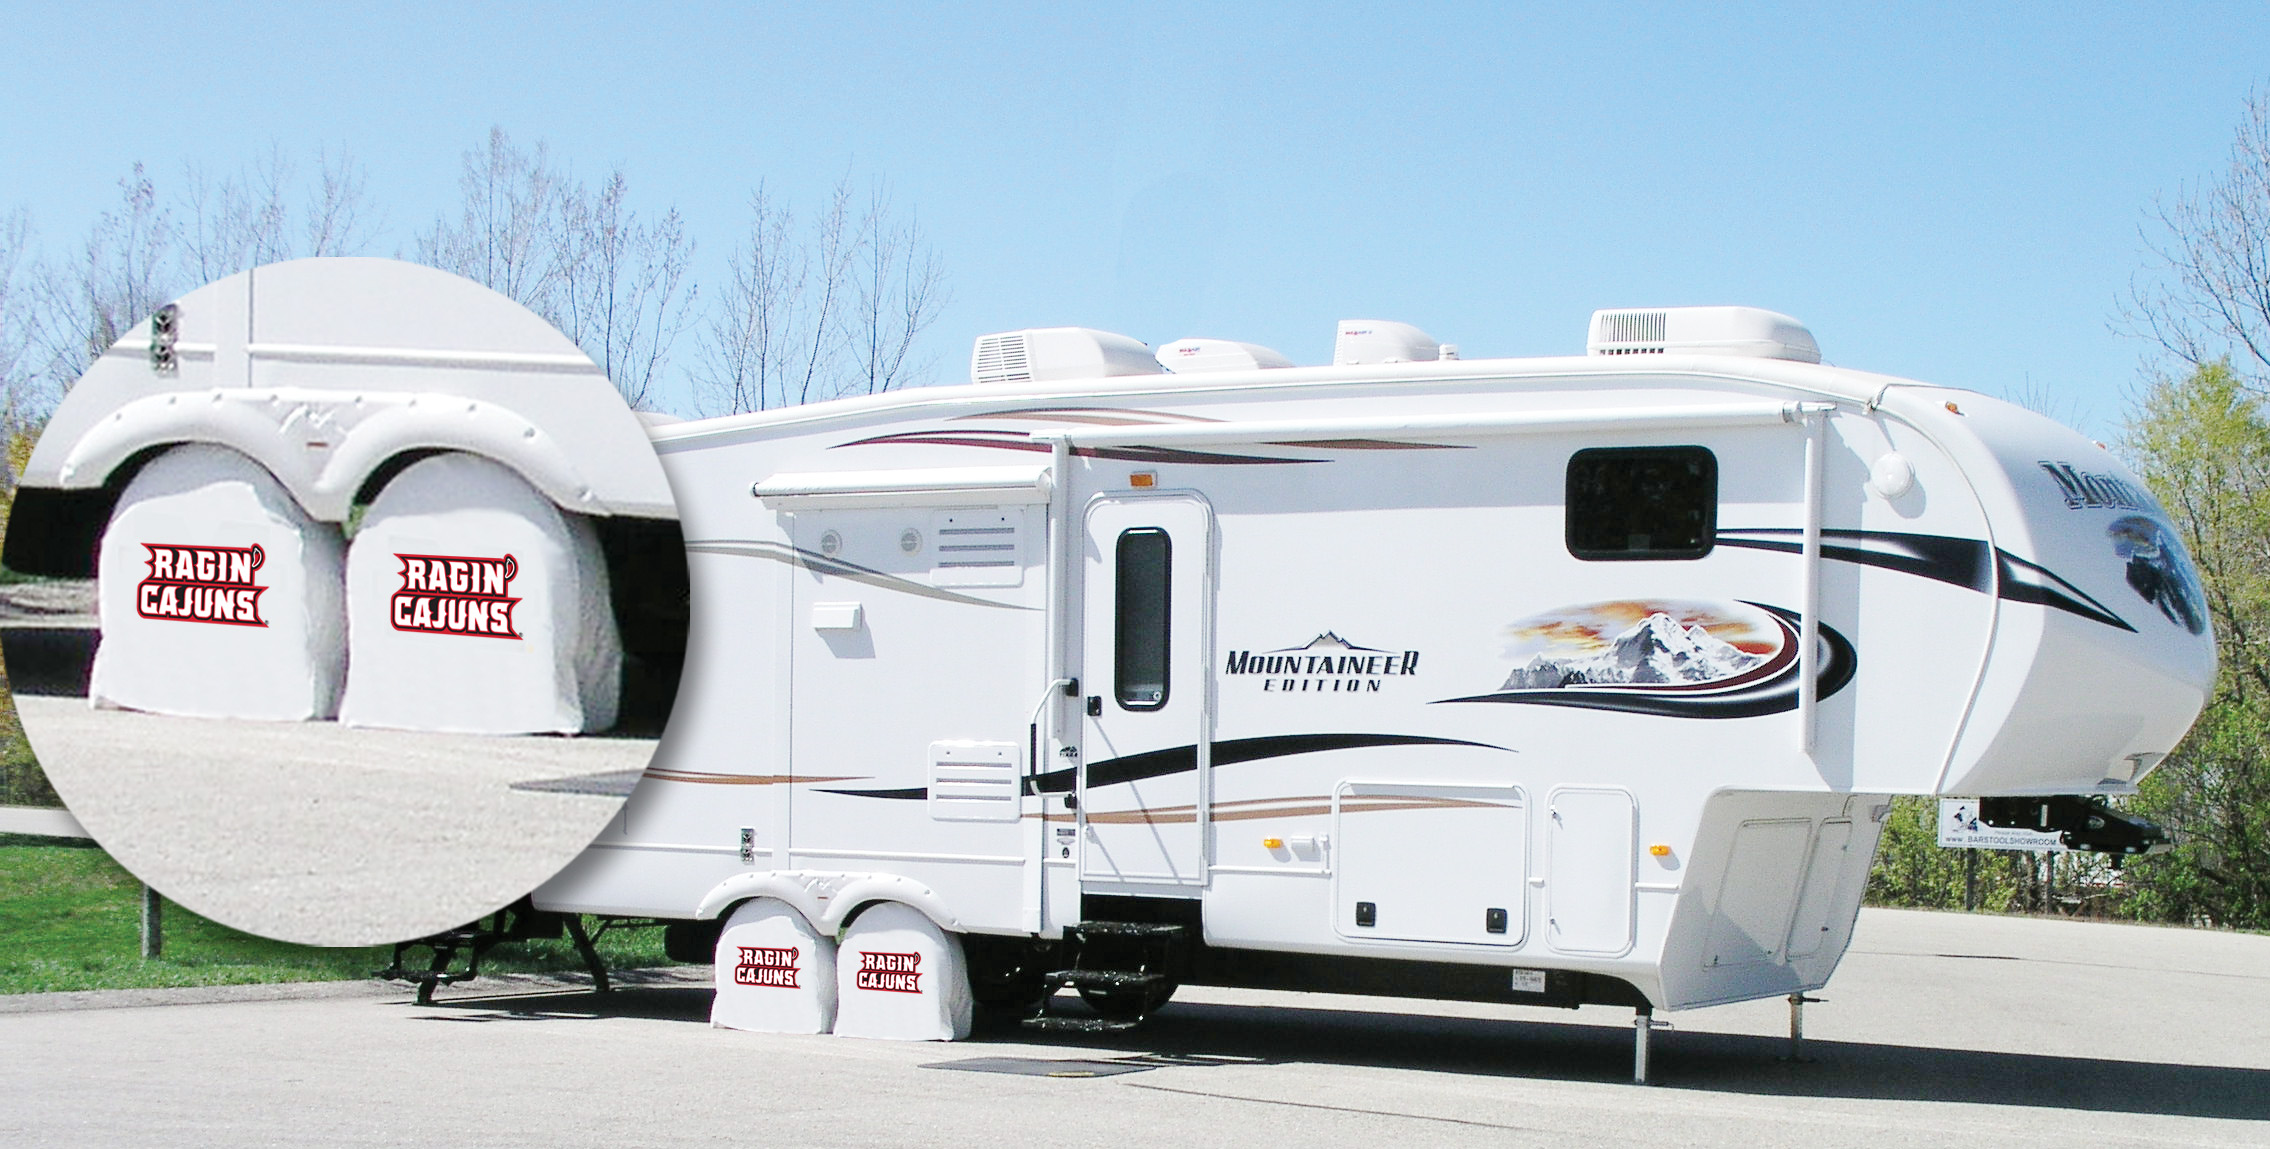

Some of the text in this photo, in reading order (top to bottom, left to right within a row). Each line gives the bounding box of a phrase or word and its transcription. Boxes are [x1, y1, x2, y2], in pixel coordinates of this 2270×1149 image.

[140, 585, 256, 622] CAJUNS
[393, 596, 509, 634] CAJUNS
[1225, 650, 1420, 676] MOUNTAINEER
[1263, 678, 1382, 692] EDITION
[1967, 835, 2057, 846] BARSTOOLSHOWROOM
[736, 967, 795, 987] CAJUNS
[858, 972, 917, 991] CAJUNS
